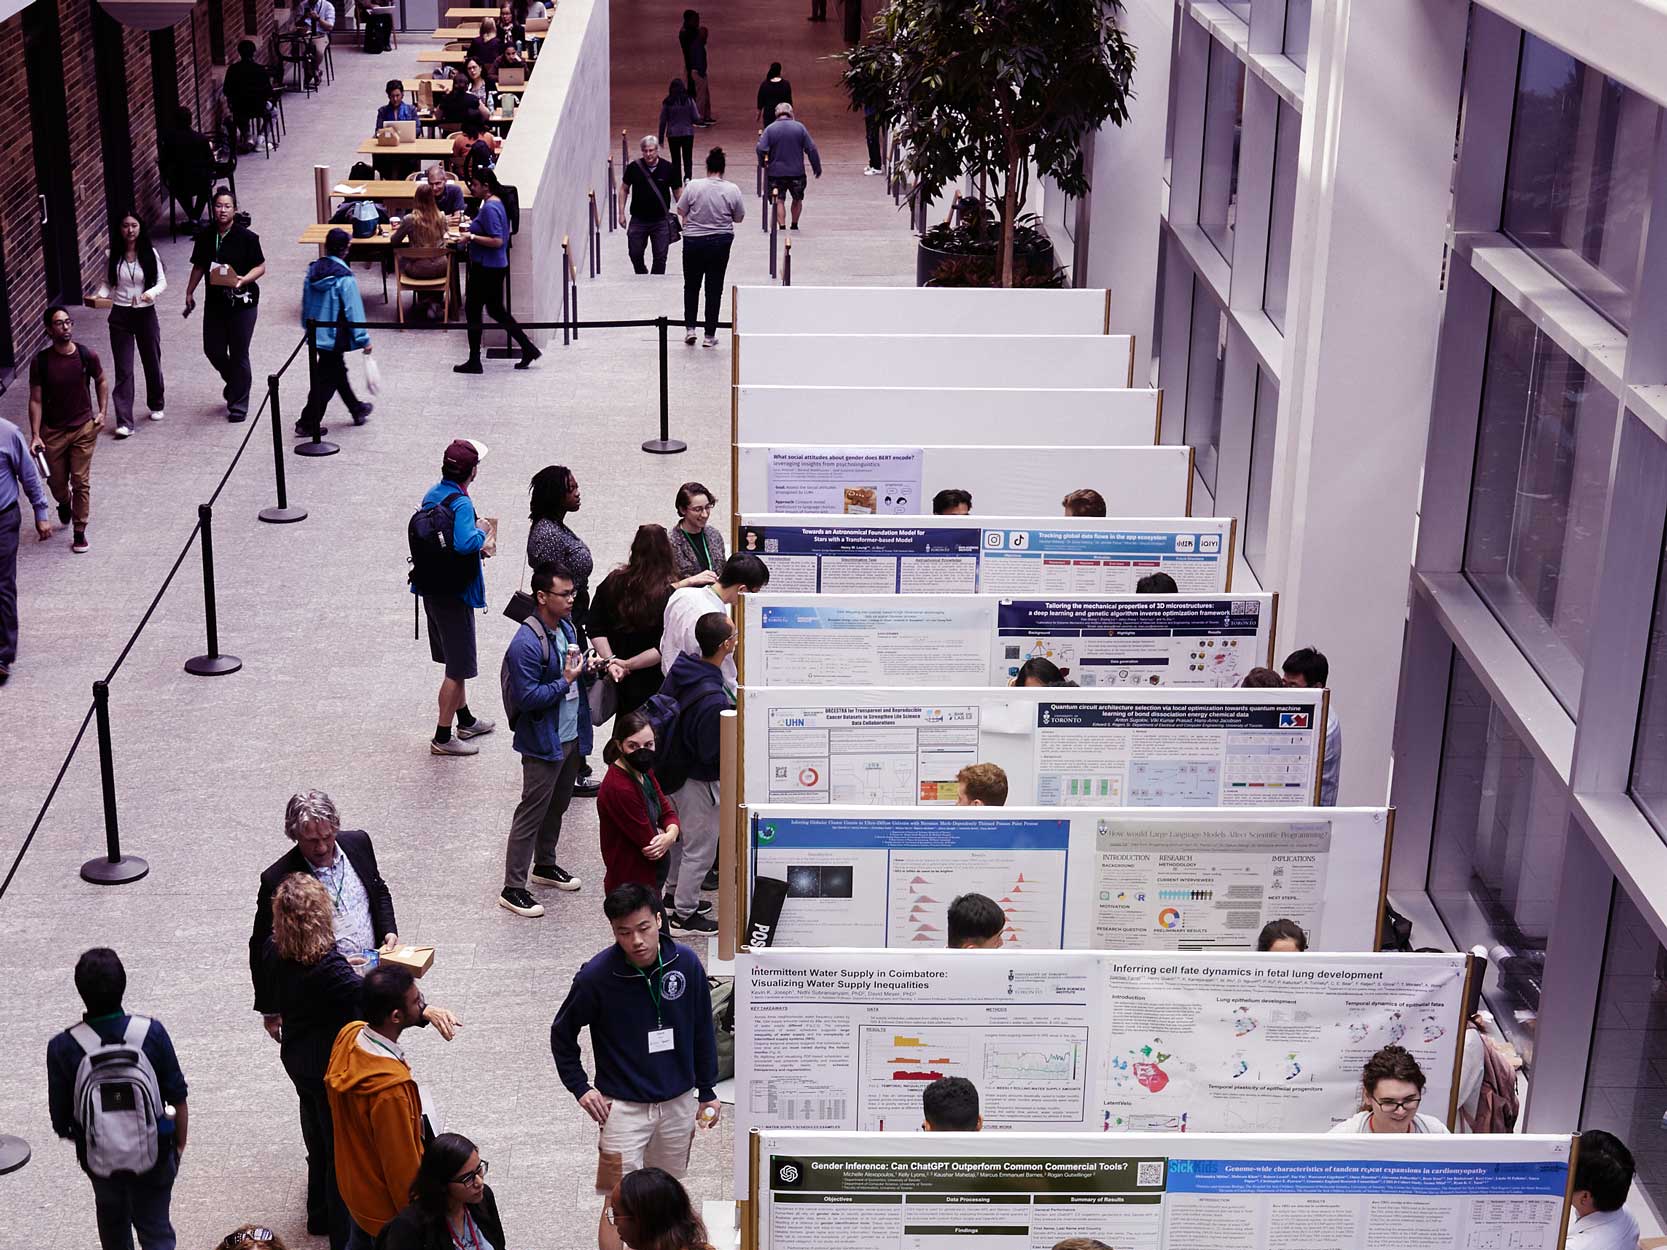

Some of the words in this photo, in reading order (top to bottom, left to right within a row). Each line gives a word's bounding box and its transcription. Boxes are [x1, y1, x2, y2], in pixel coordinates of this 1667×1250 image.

[1045, 602, 1072, 610] Tailoring
[1049, 610, 1074, 618] learning
[1199, 610, 1231, 618] framework
[785, 718, 805, 727] UHN
[751, 968, 807, 977] Intermittent
[809, 969, 838, 977] Water
[840, 969, 874, 979] Supply
[877, 969, 886, 978] in
[888, 970, 948, 978] Coimbatore:
[1113, 964, 1157, 975] Inferring
[1159, 965, 1178, 974] cell
[1180, 966, 1200, 975] fate
[1202, 968, 1252, 977] dynamics
[1254, 968, 1264, 977] in
[1267, 968, 1289, 978] fetal
[1292, 970, 1315, 980] lung
[1317, 970, 1383, 980] development
[751, 979, 804, 989] Visualizing
[806, 979, 835, 988] Water
[837, 980, 871, 990] Supply
[874, 981, 929, 990] Inequalities
[811, 1161, 844, 1170] Gender
[845, 1162, 889, 1170] Inference:
[890, 1162, 909, 1171] Can
[910, 1162, 950, 1171] ChatGPT
[951, 1162, 1002, 1171] Outperform
[1003, 1162, 1043, 1171] Common
[1044, 1162, 1097, 1171] Commercial
[1099, 1162, 1128, 1171] Tools?
[1431, 1167, 1487, 1176] cardiomyopathy
